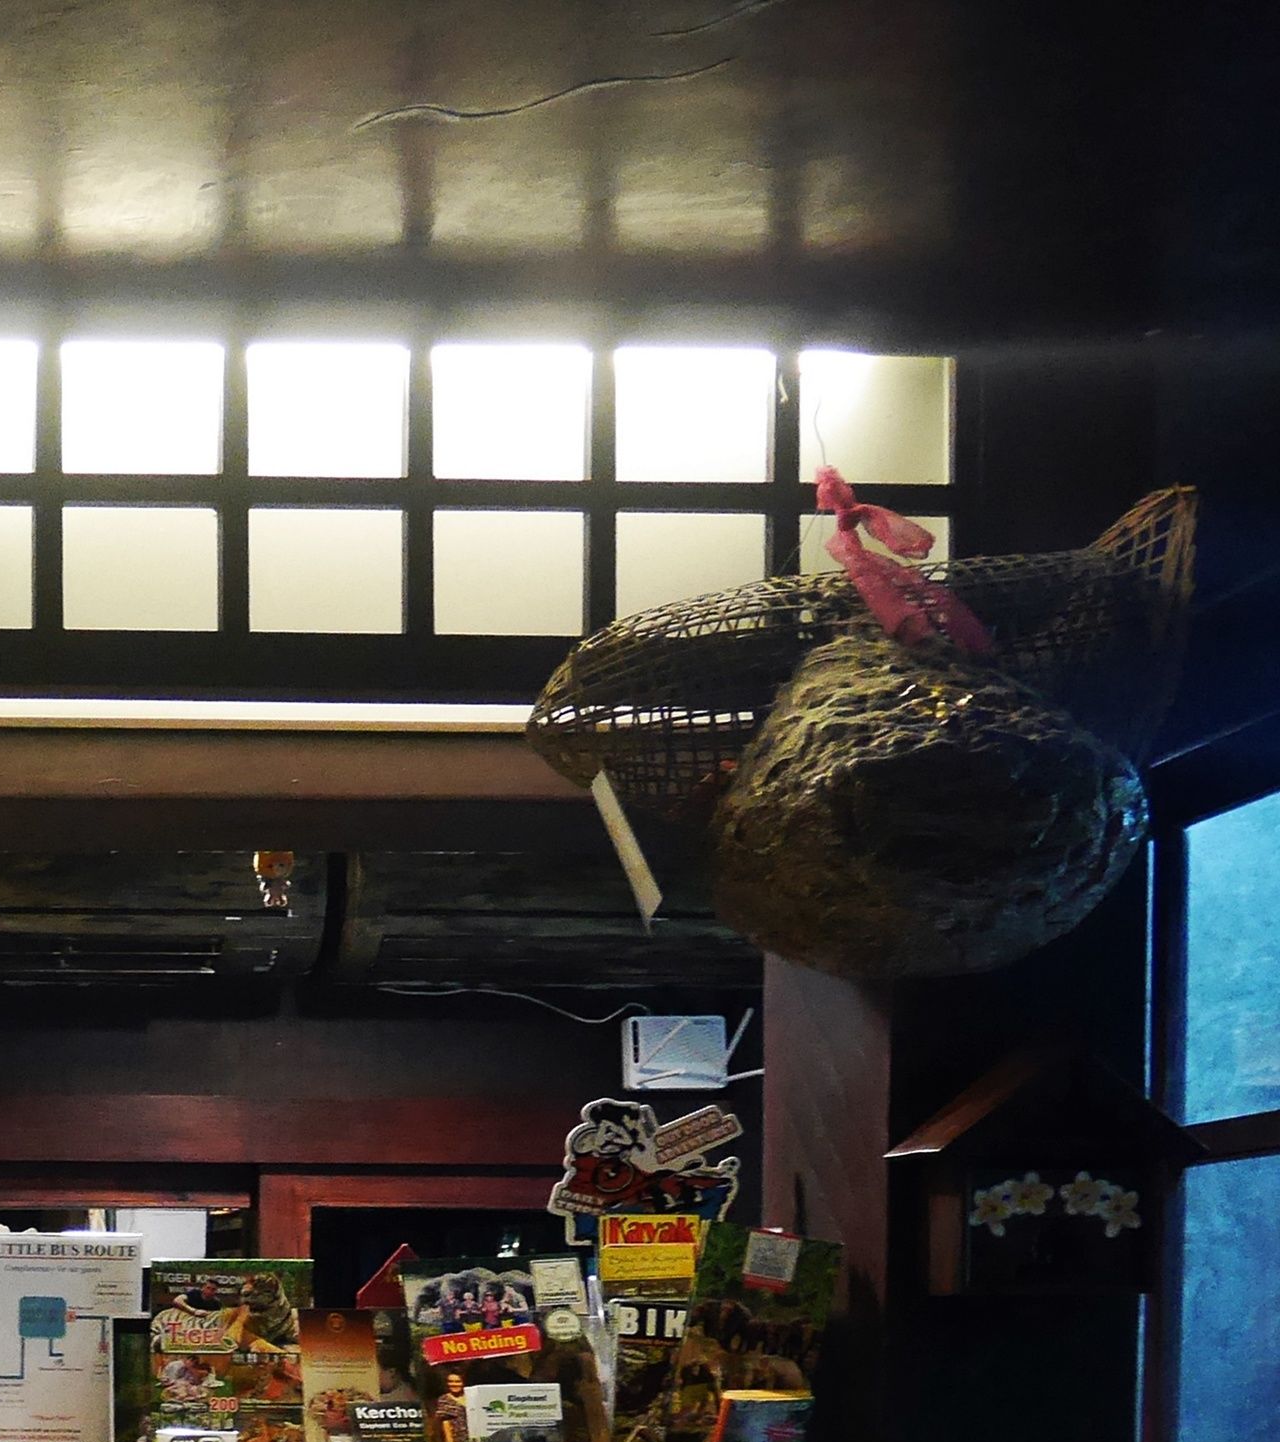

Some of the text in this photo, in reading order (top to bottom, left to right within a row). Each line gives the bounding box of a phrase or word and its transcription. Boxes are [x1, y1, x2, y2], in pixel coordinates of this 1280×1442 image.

[608, 1217, 695, 1244] Kayak
[50, 1243, 81, 1256] BUS
[83, 1244, 137, 1258] ROUTE
[155, 1271, 192, 1284] TIGER
[441, 1334, 527, 1356] No Riding
[209, 1397, 240, 1413] 200
